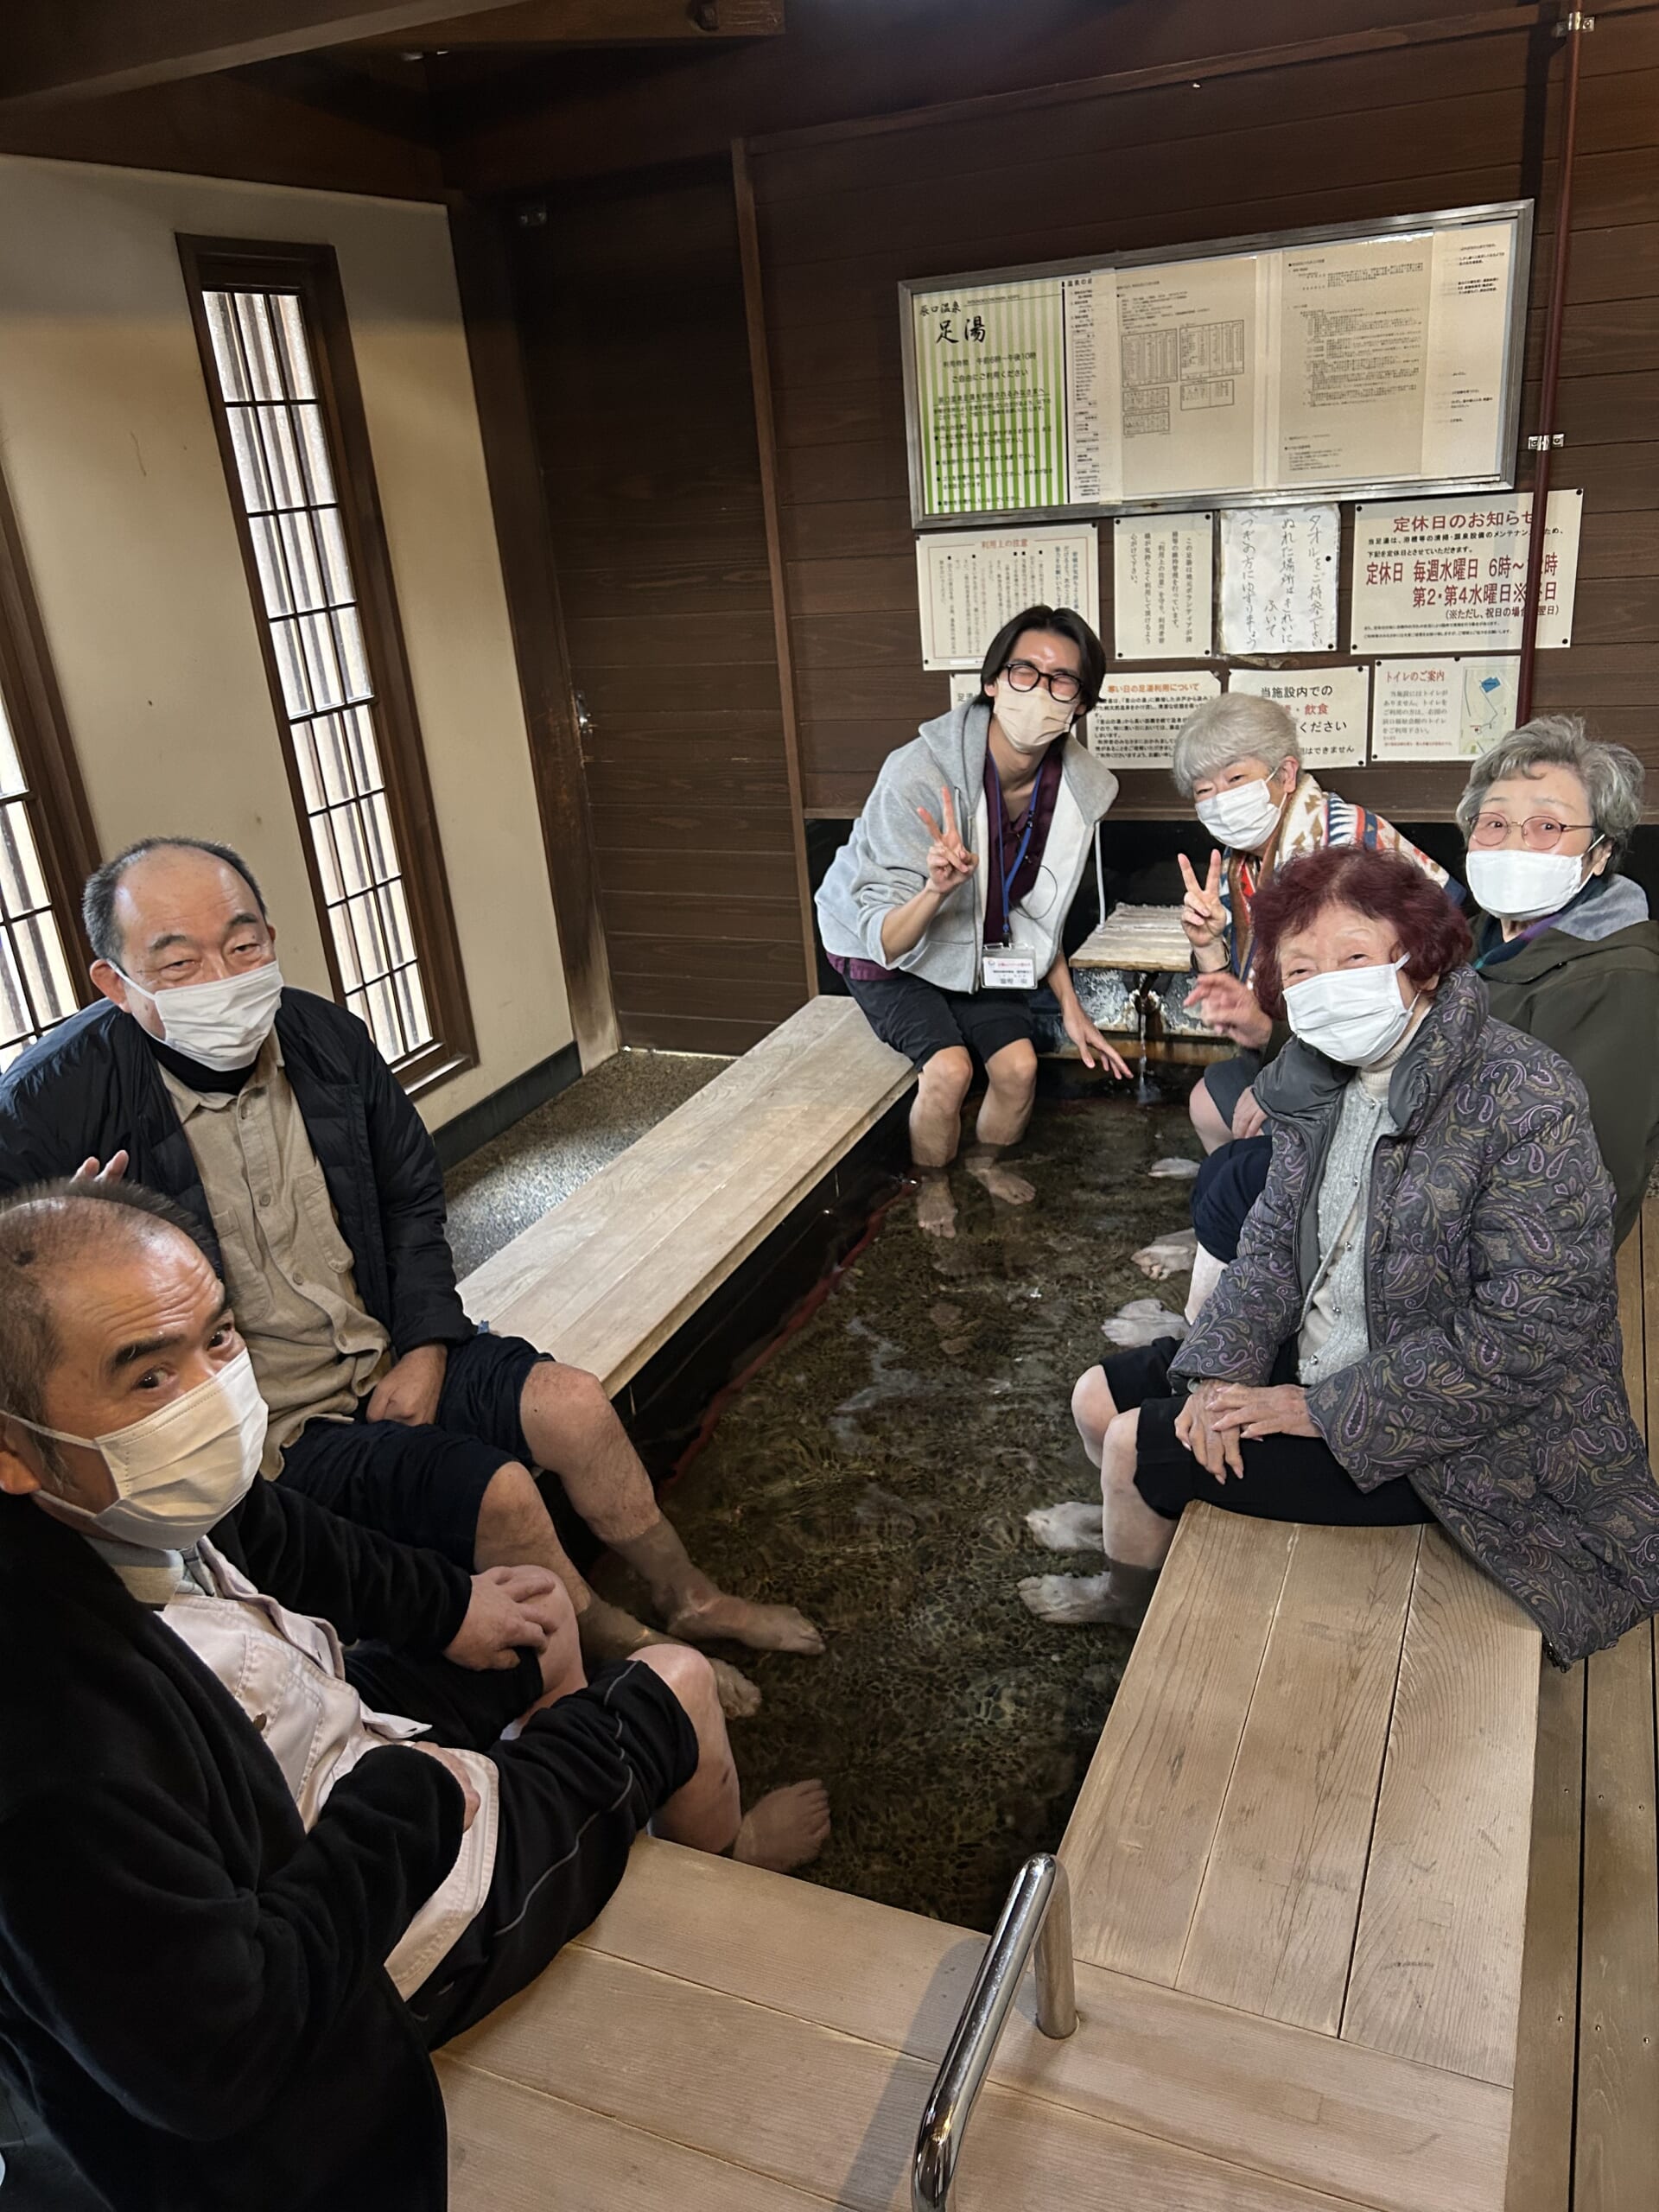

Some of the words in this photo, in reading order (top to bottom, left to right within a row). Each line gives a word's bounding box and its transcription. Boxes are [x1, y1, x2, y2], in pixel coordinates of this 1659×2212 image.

[936, 315, 986, 344] 足湯
[1393, 510, 1533, 533] 定休日のお知らせ
[1366, 562, 1403, 586] 定休日
[1414, 557, 1478, 582] 毎週水曜日
[1413, 582, 1557, 607] 第2・第4水曜日※日
[1386, 670, 1445, 683] トイレのご案内
[1261, 685, 1333, 698] 当施設内での
[1300, 721, 1347, 733] ください
